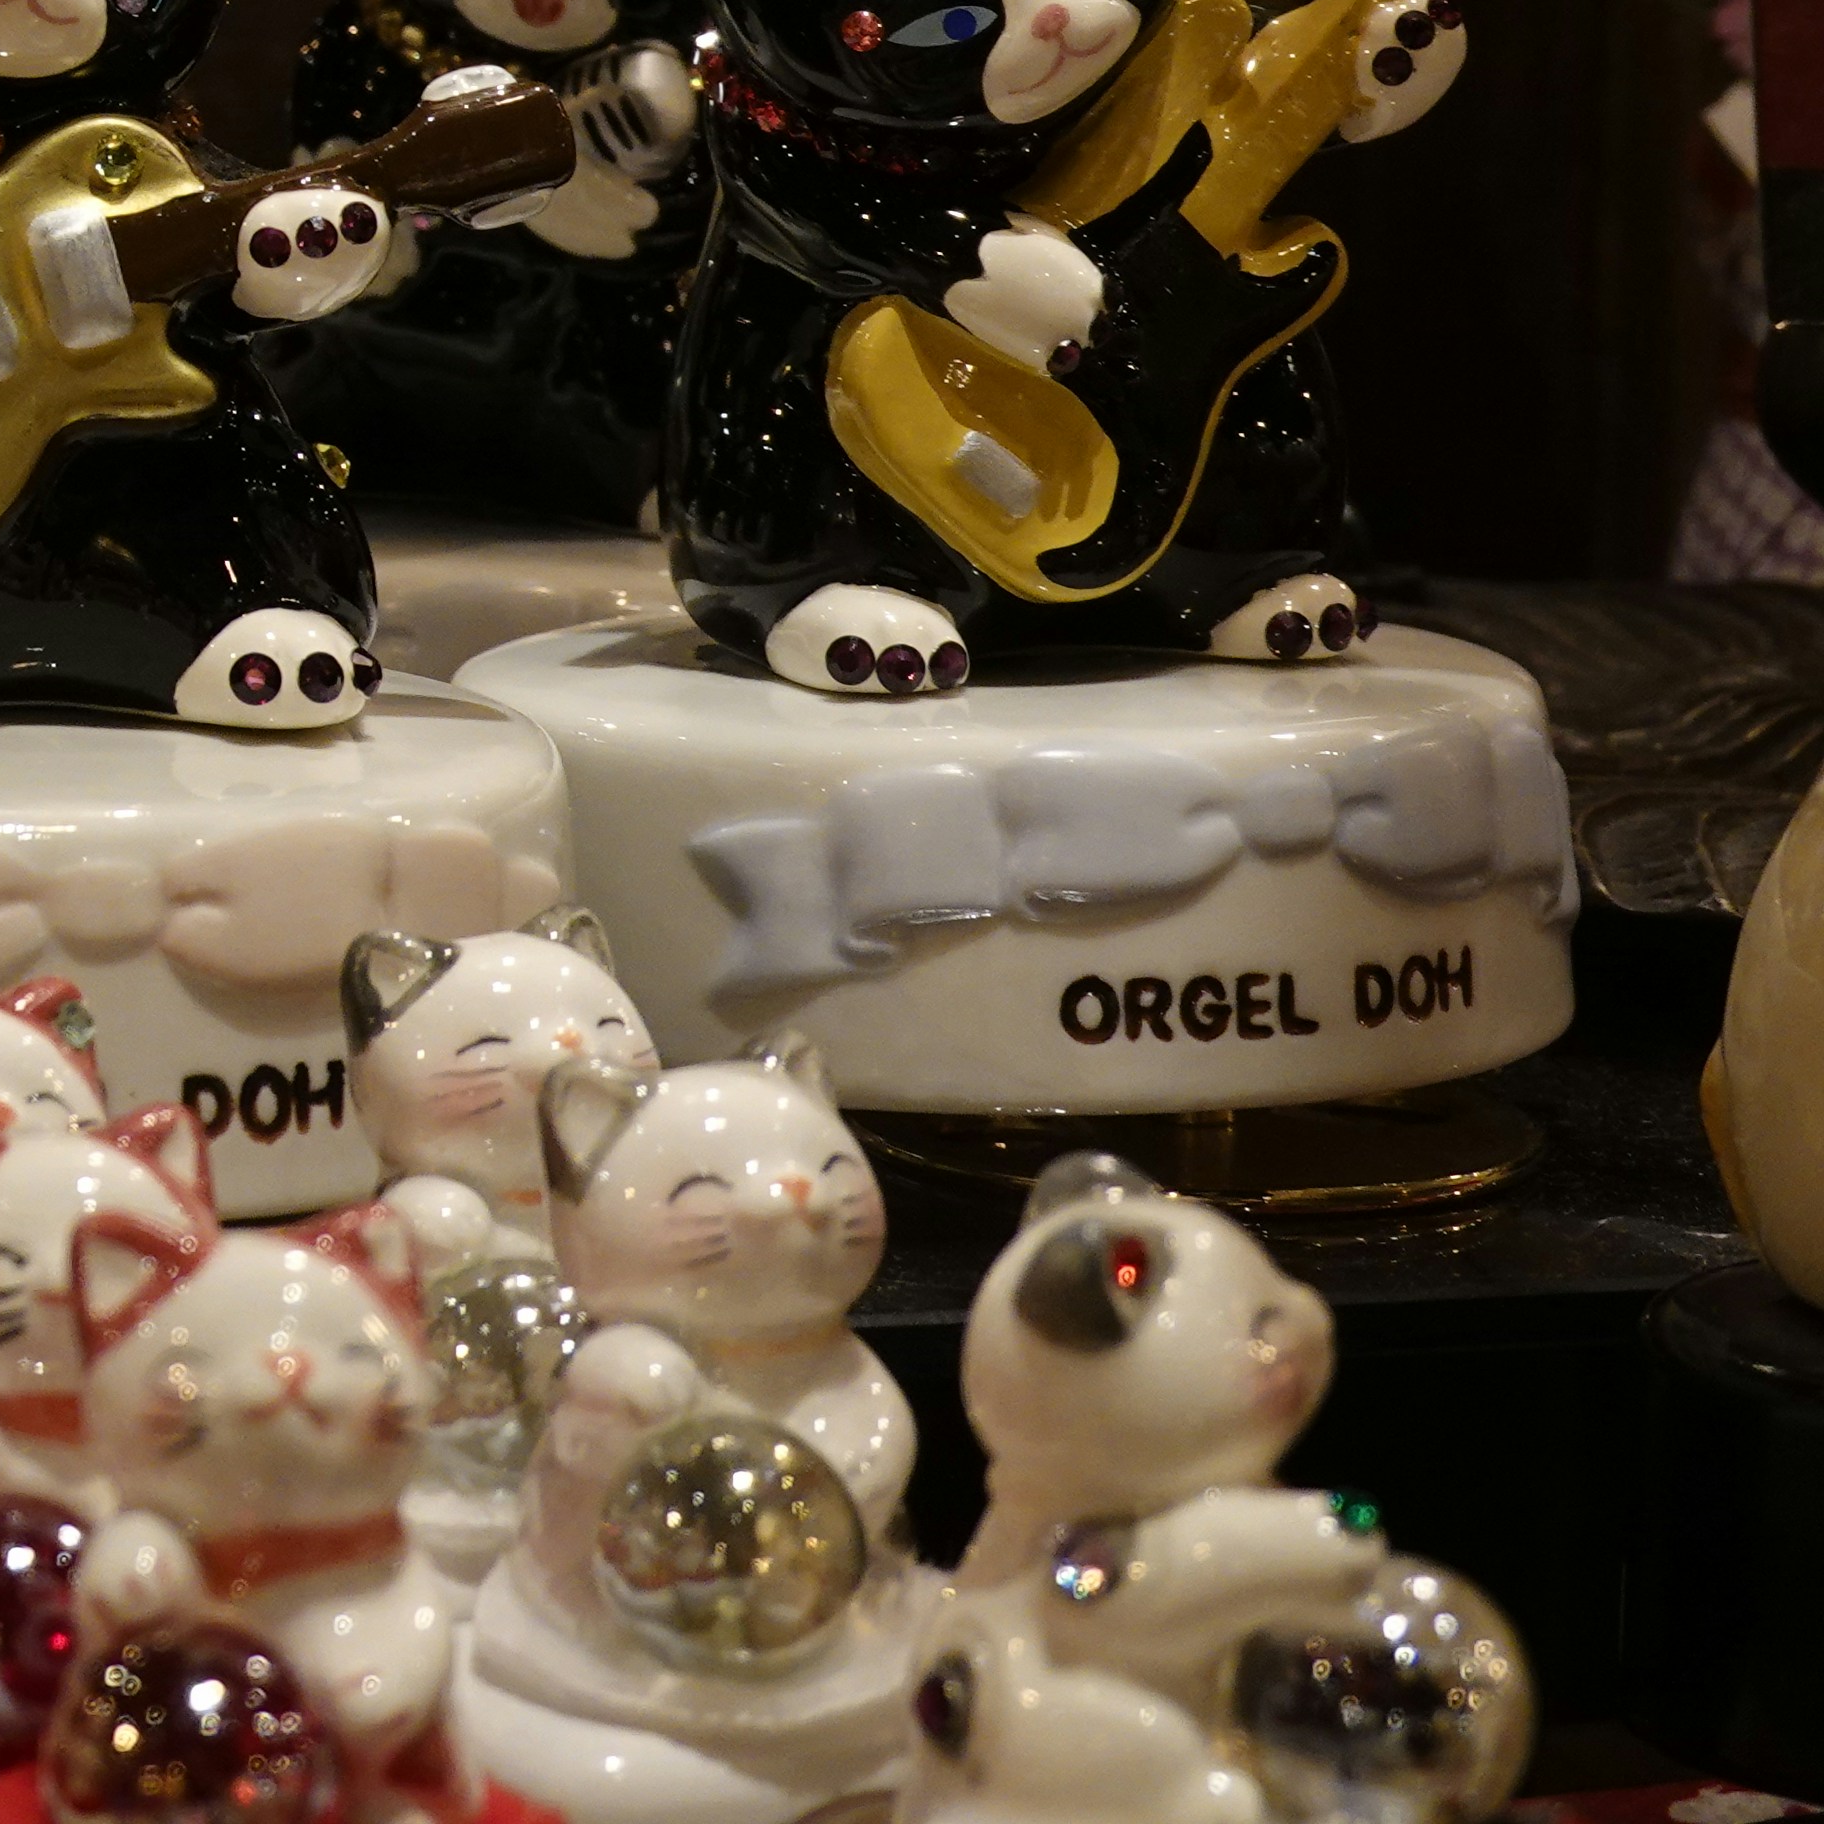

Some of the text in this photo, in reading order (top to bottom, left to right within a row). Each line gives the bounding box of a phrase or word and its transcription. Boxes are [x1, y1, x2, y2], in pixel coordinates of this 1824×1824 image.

[1059, 944, 1473, 1045] ORGEL DOH
[182, 1059, 345, 1145] DOH
